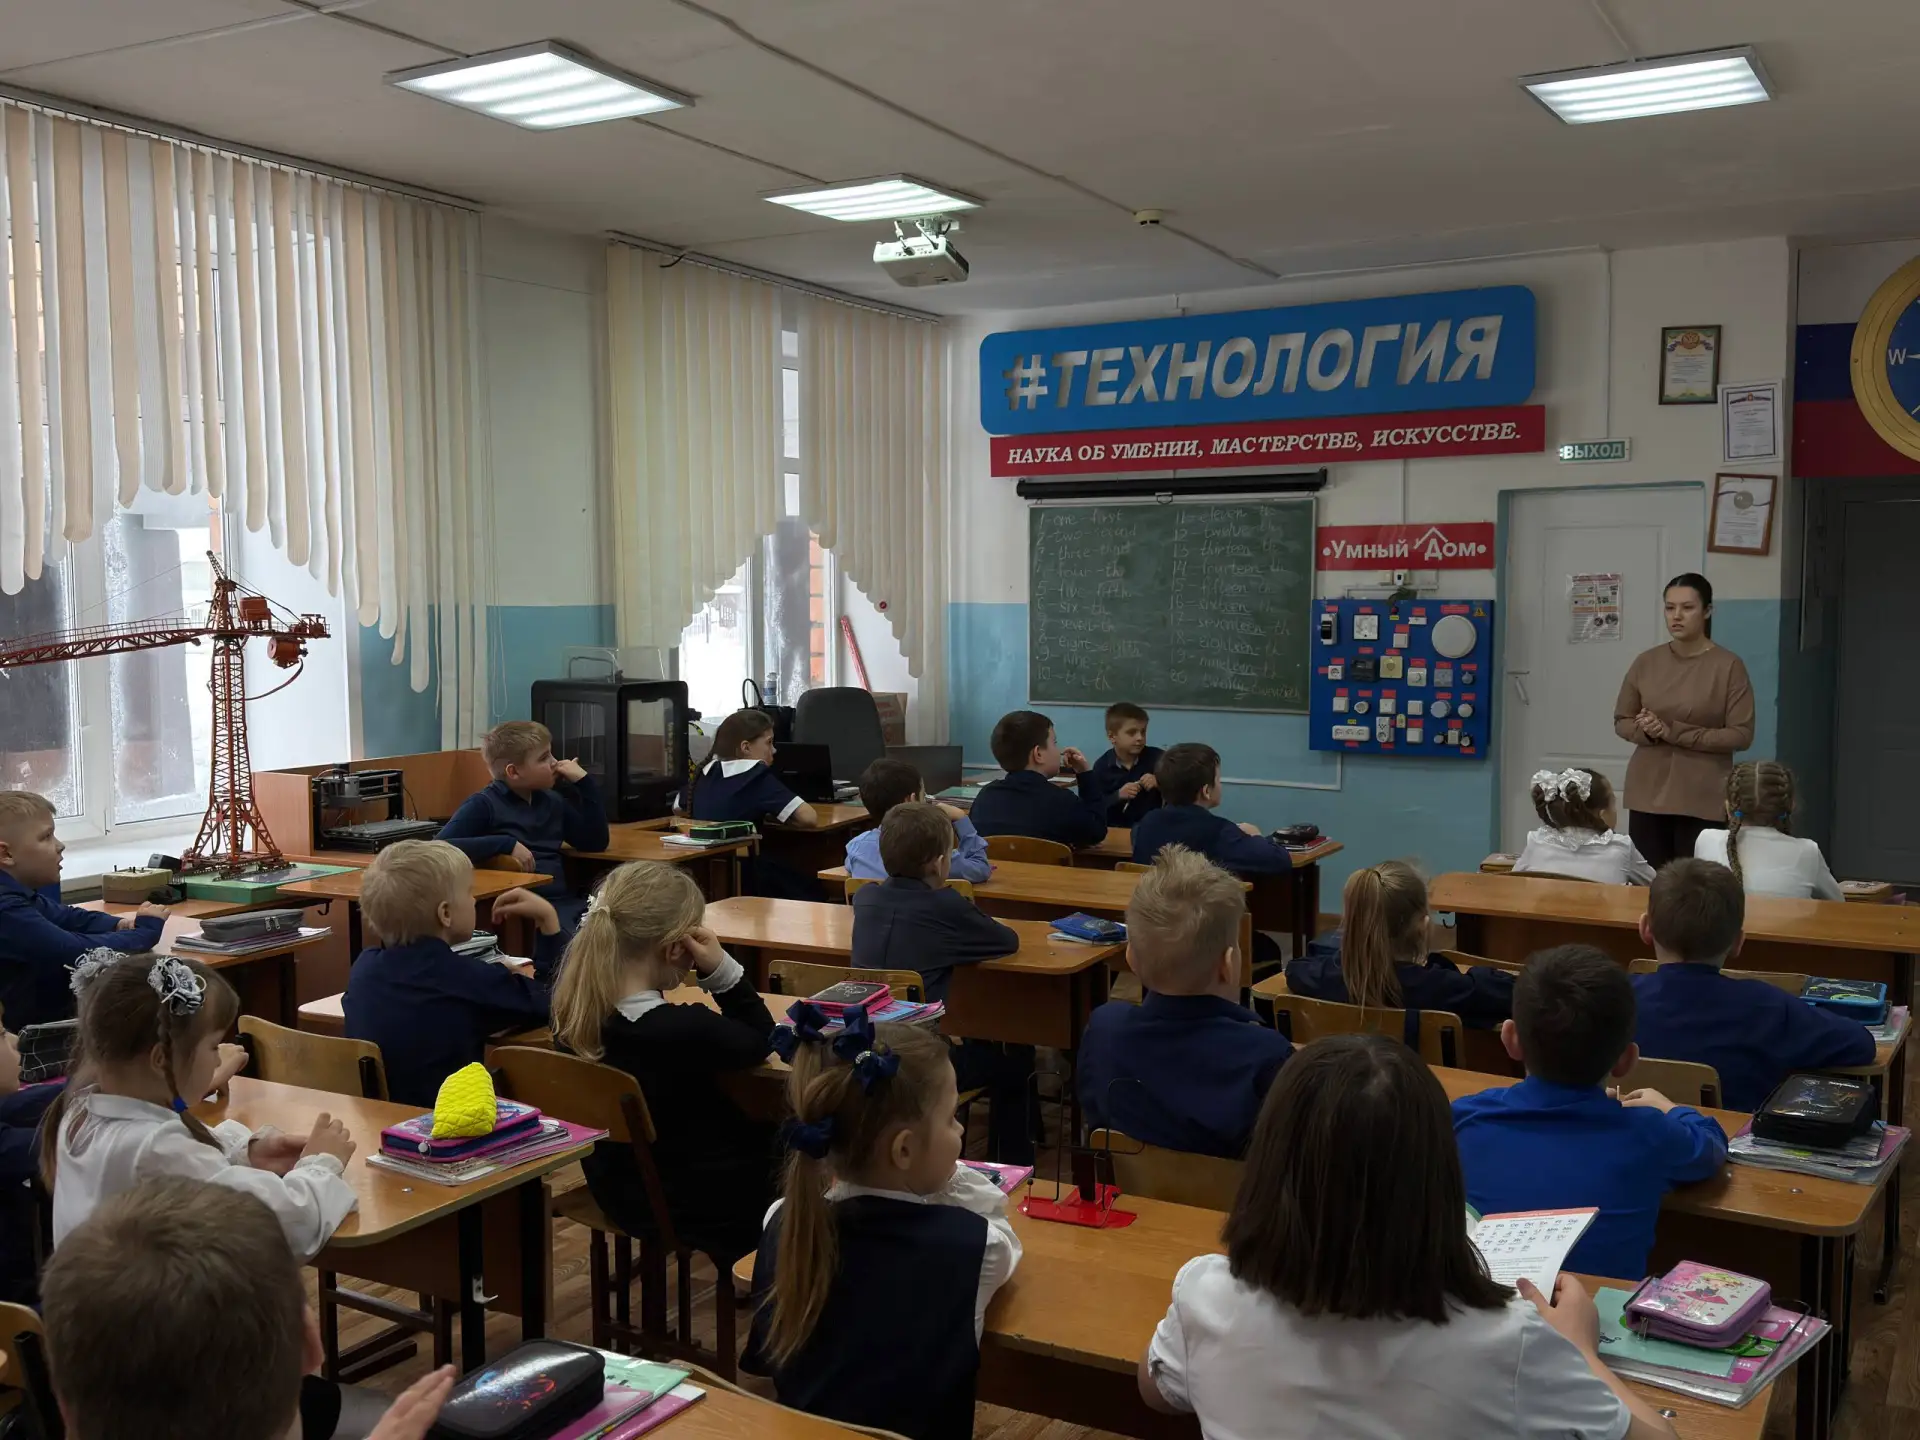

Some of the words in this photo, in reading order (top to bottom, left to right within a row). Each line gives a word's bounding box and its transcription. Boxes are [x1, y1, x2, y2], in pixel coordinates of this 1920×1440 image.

[1002, 315, 1504, 412] #ТЕХНОЛОГИЯ
[1884, 347, 1907, 366] W
[1007, 445, 1074, 465] НАУКА
[1078, 444, 1106, 461] ОБ
[1110, 439, 1205, 460] УМЕНИИ,
[1209, 431, 1364, 456] МАСТЕРСТВЕ,
[1370, 421, 1522, 449] ИСКУССТВЕ.
[1563, 443, 1623, 460] ВЫХОД
[1330, 538, 1409, 560] Умный
[1424, 538, 1476, 561] Дом
